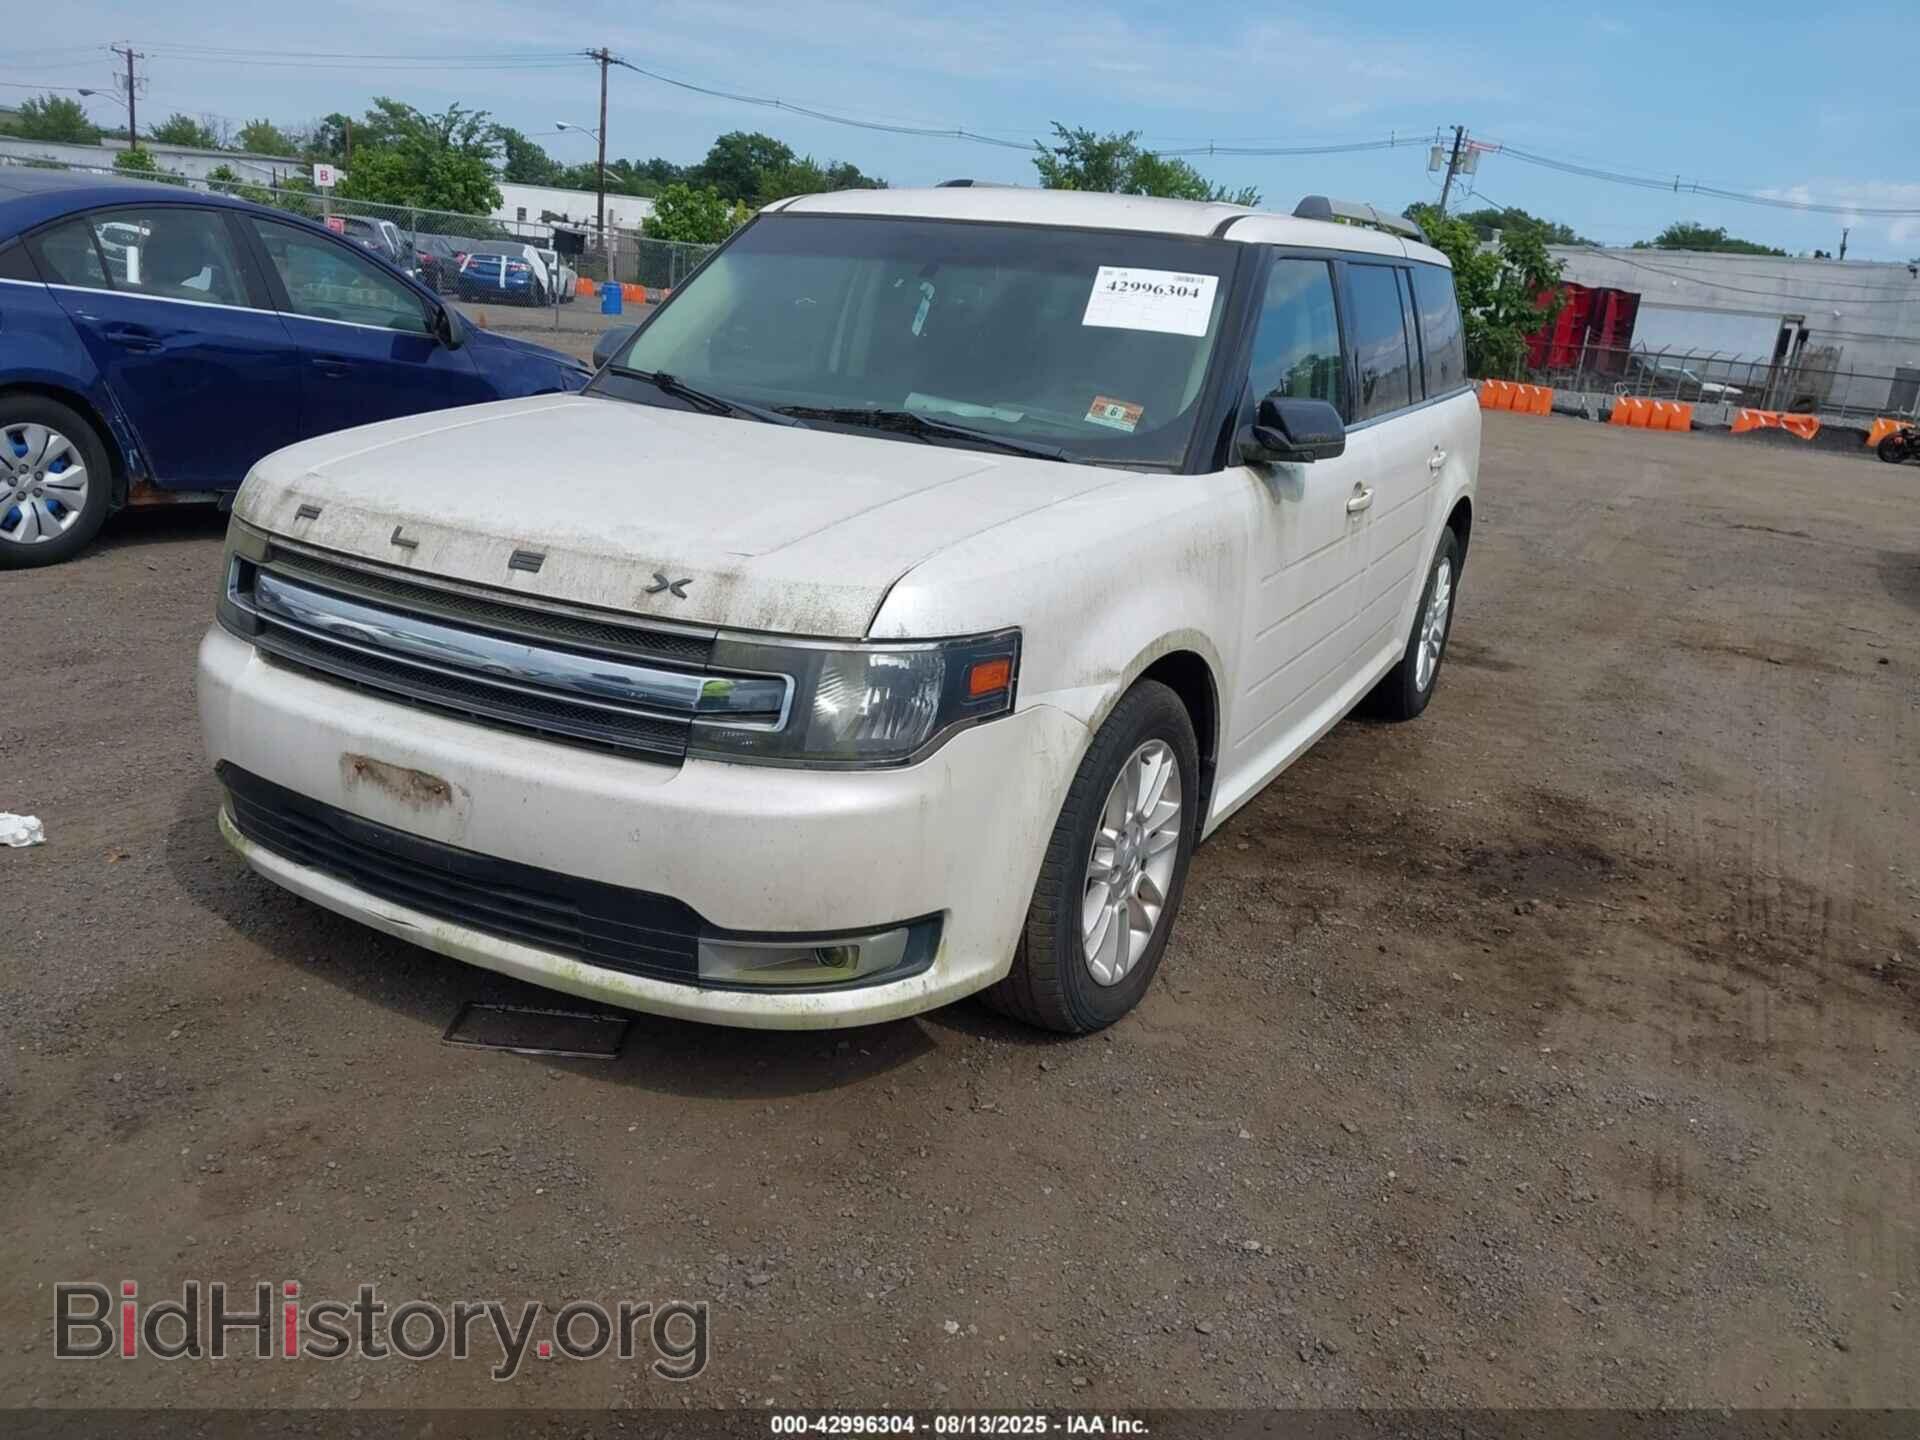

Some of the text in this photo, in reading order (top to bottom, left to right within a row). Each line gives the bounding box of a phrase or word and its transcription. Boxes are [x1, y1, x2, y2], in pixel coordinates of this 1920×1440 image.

[319, 169, 329, 181] B
[1106, 279, 1200, 299] 42996304
[294, 503, 694, 600] FLEX
